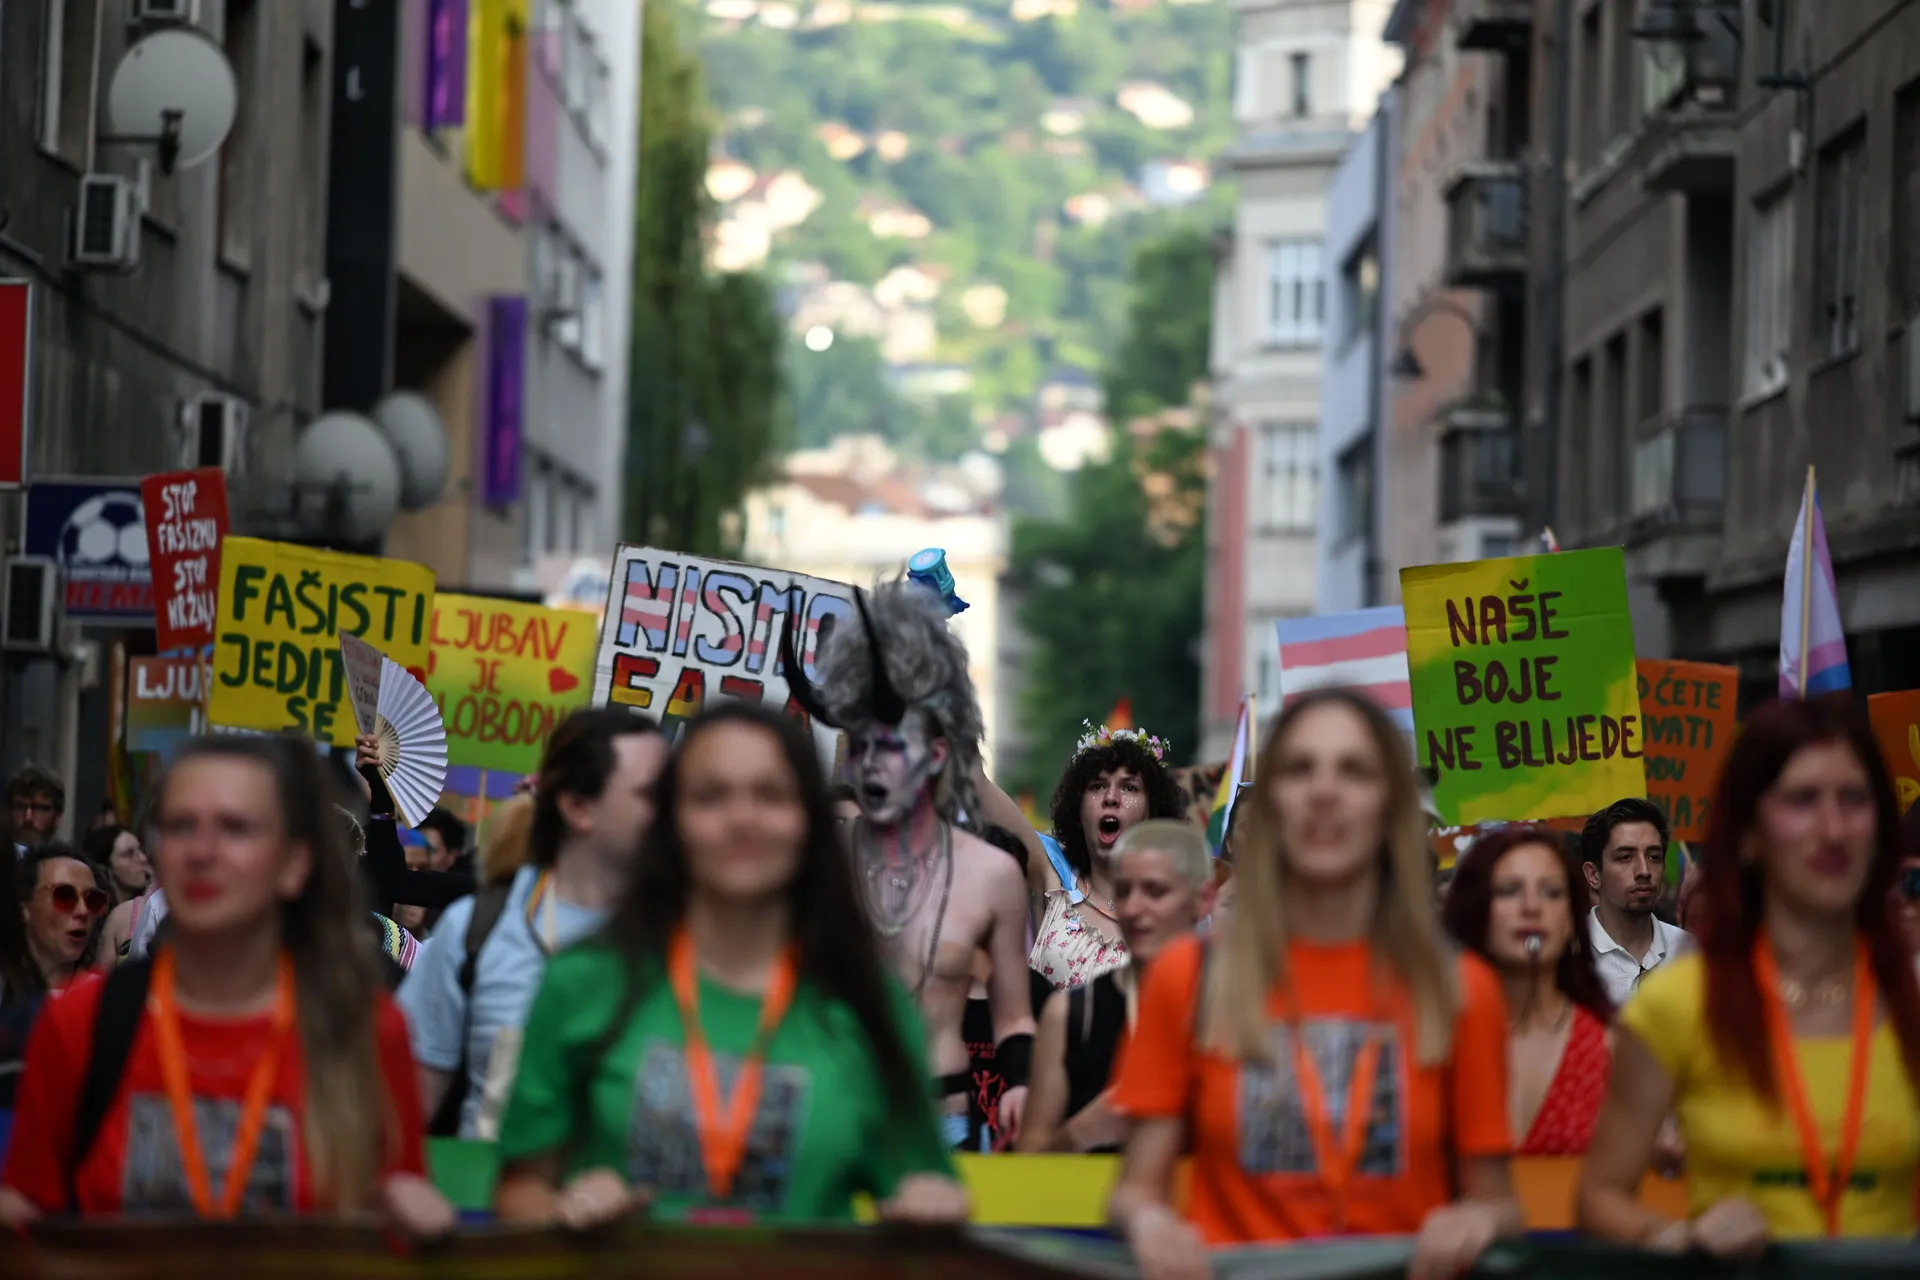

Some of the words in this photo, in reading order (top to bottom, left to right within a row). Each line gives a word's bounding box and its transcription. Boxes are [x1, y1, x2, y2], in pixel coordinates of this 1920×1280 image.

[161, 480, 198, 521] STOP
[174, 555, 208, 593] STOP
[233, 569, 425, 645] FAŠISTI
[614, 558, 854, 687] NISMO
[1445, 577, 1570, 648] NAŠE
[431, 609, 568, 661] LJUBAV
[219, 633, 346, 704] JEDIT
[470, 658, 504, 694] JE
[1453, 655, 1563, 706] BOJE
[282, 696, 338, 743] SE
[1426, 725, 1483, 771] NE
[1494, 713, 1645, 770] BLIJEDE
